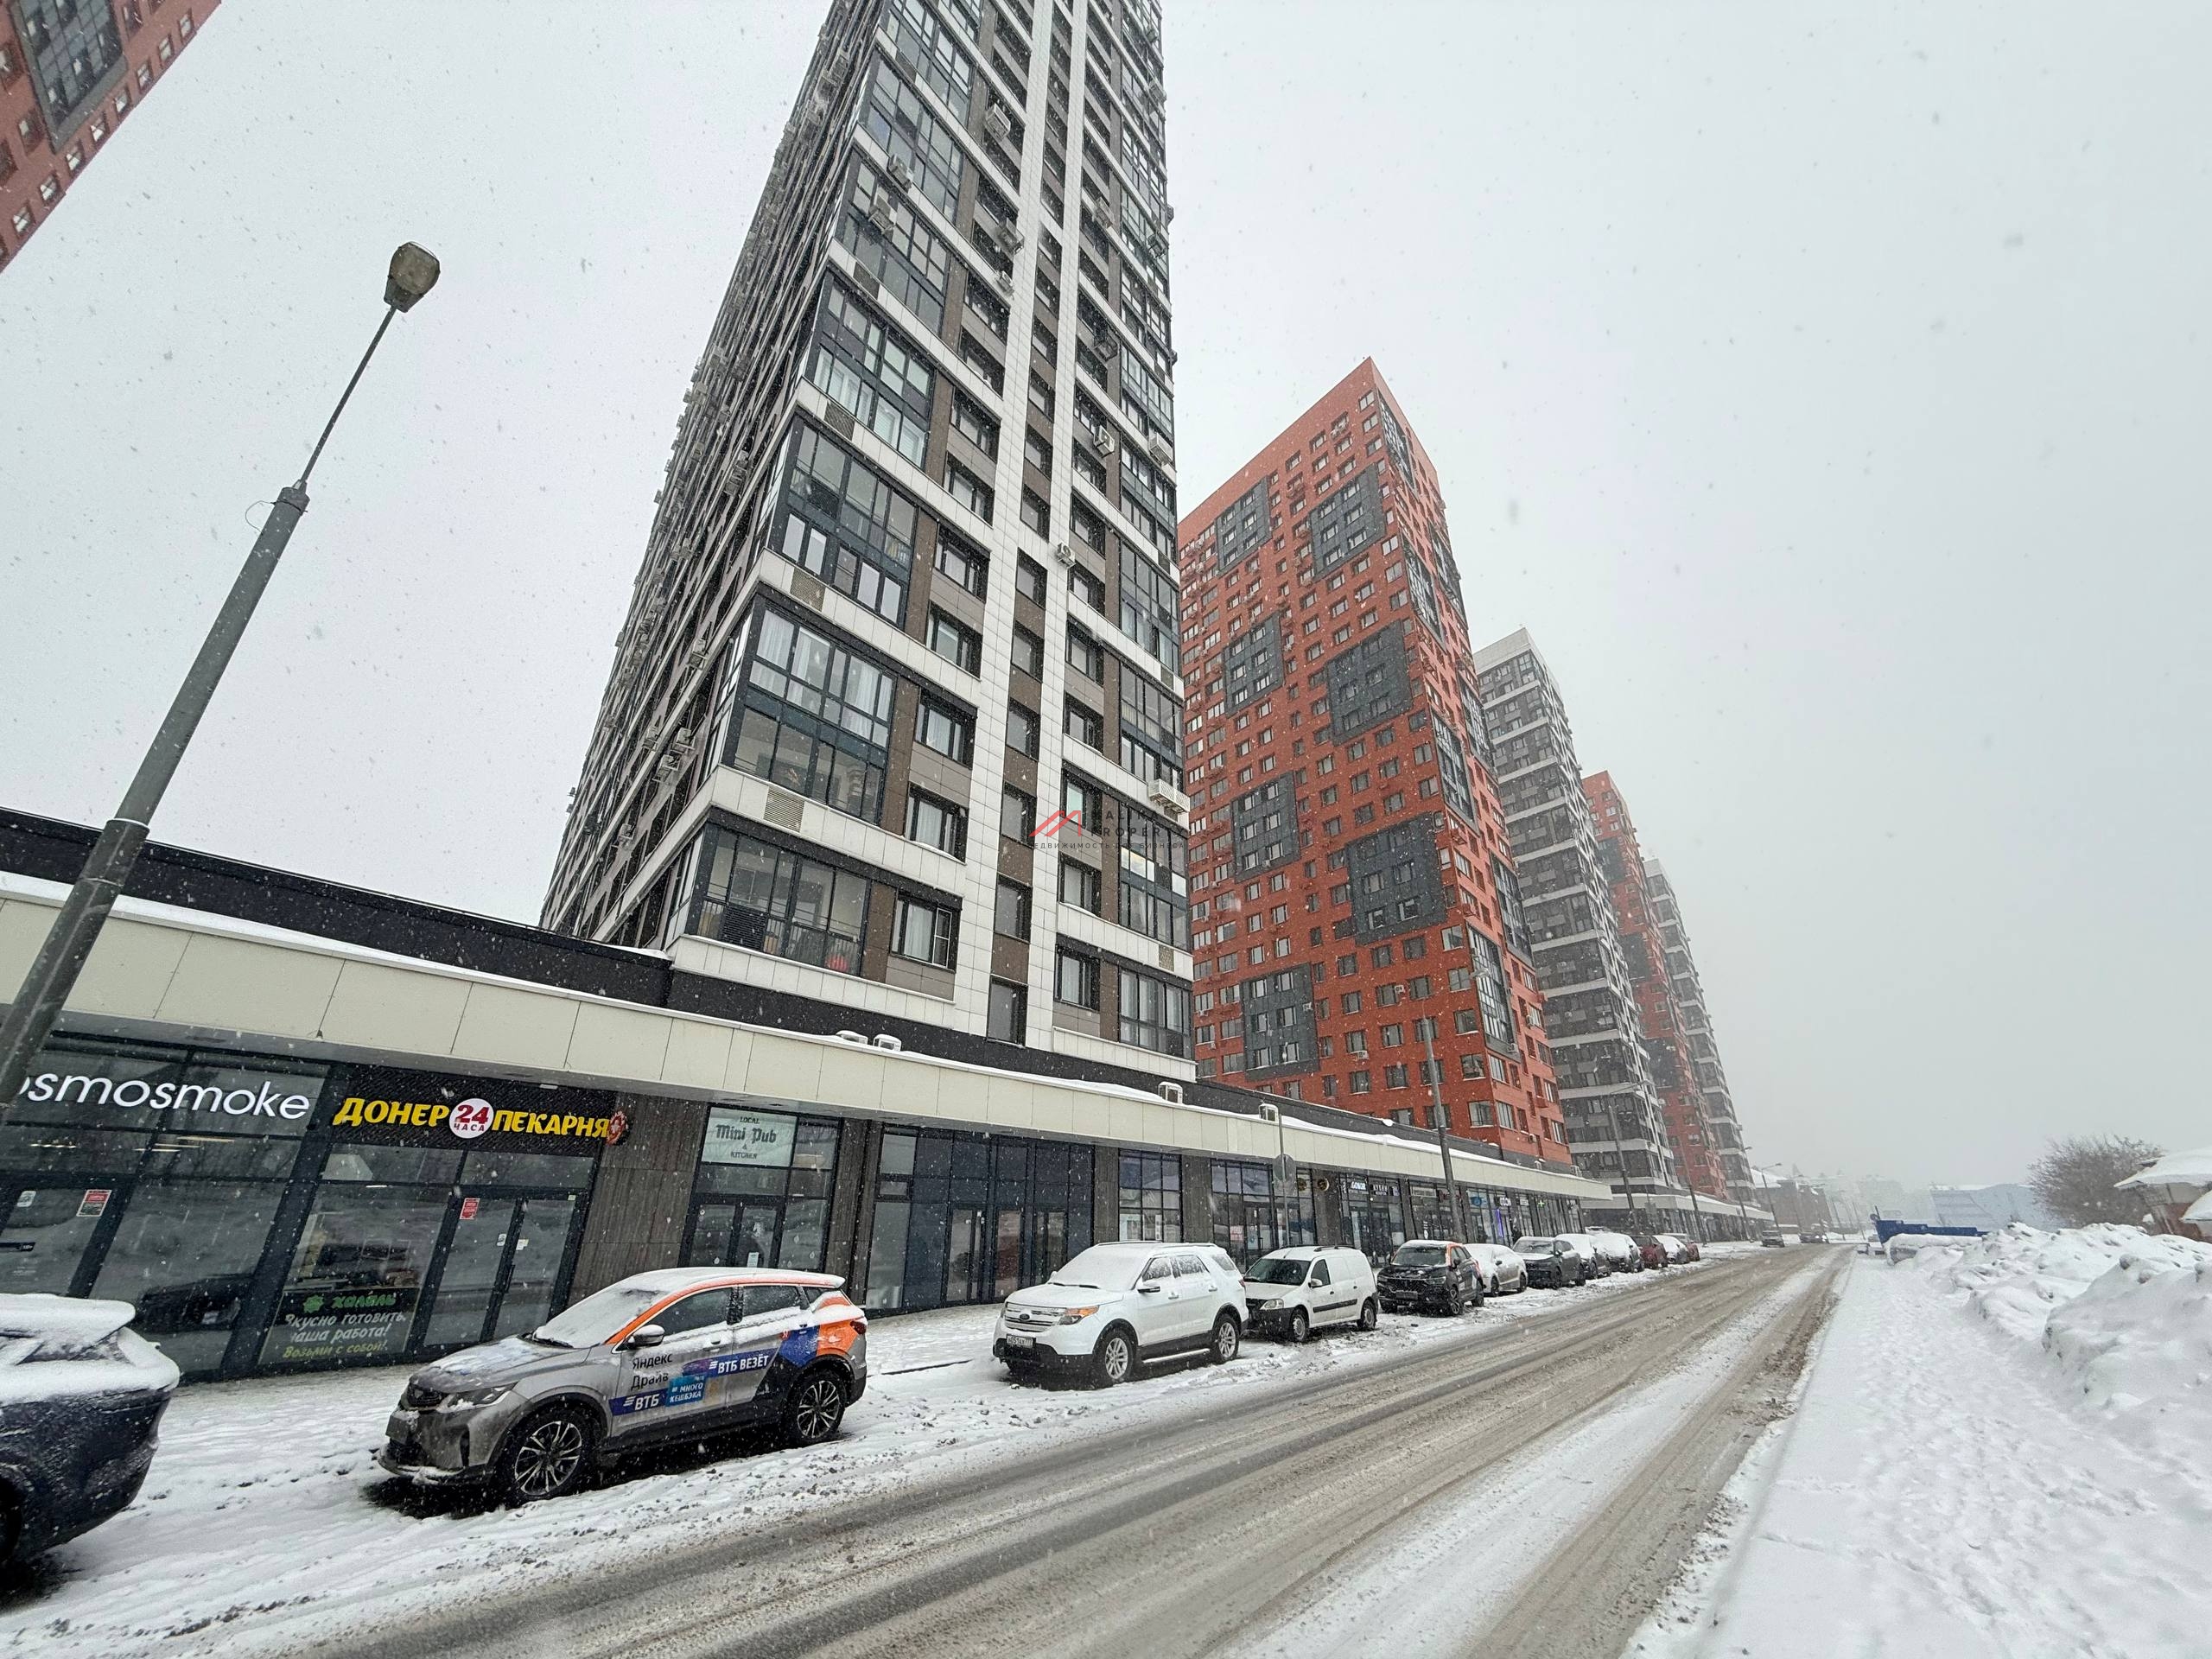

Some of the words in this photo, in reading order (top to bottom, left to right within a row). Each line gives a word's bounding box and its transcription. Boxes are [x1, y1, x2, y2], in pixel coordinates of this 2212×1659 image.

[19, 1073, 310, 1120] smosmoke
[332, 1097, 450, 1127] ДОНЕР
[454, 1104, 489, 1123] 24
[740, 1116, 760, 1125] LOCAL
[454, 1123, 486, 1132] ЧАСА
[492, 1109, 611, 1138] ПЕКАРНЯ
[715, 1124, 747, 1141] Mini
[751, 1127, 778, 1144] Pub
[730, 1151, 758, 1160] KITCHEN
[330, 1323, 392, 1344] работа!
[632, 1353, 674, 1370] Яндекс
[717, 1361, 738, 1374] ВТБ
[739, 1355, 770, 1370] ВЕЗЁТ
[631, 1372, 669, 1392] Драйв
[679, 1382, 703, 1393] МНОГО
[634, 1393, 661, 1411] ВТБ
[669, 1391, 702, 1403] КЕШБЭКА
